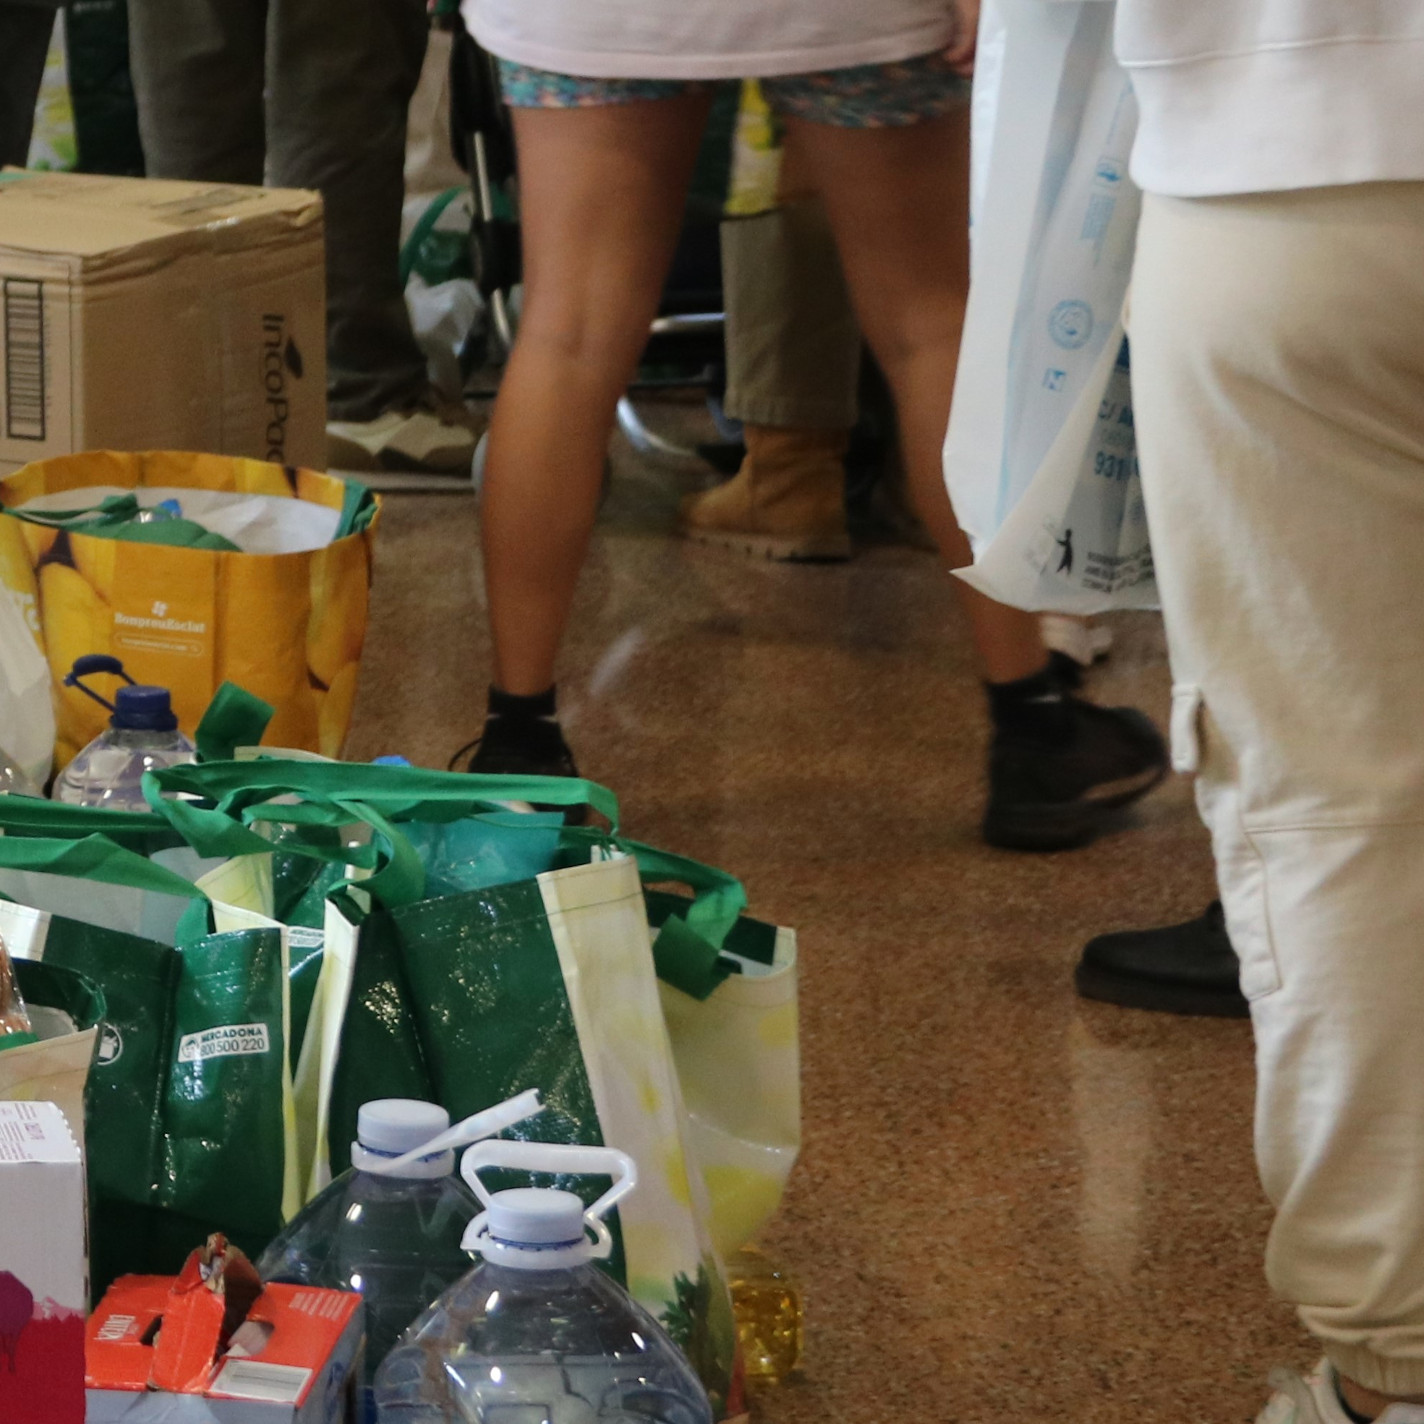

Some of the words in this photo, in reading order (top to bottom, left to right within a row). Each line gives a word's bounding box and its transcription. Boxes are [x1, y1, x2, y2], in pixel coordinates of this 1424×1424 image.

[201, 1027, 264, 1042] MERCADONA
[216, 1039, 239, 1053] 500
[242, 1037, 264, 1051] 220
